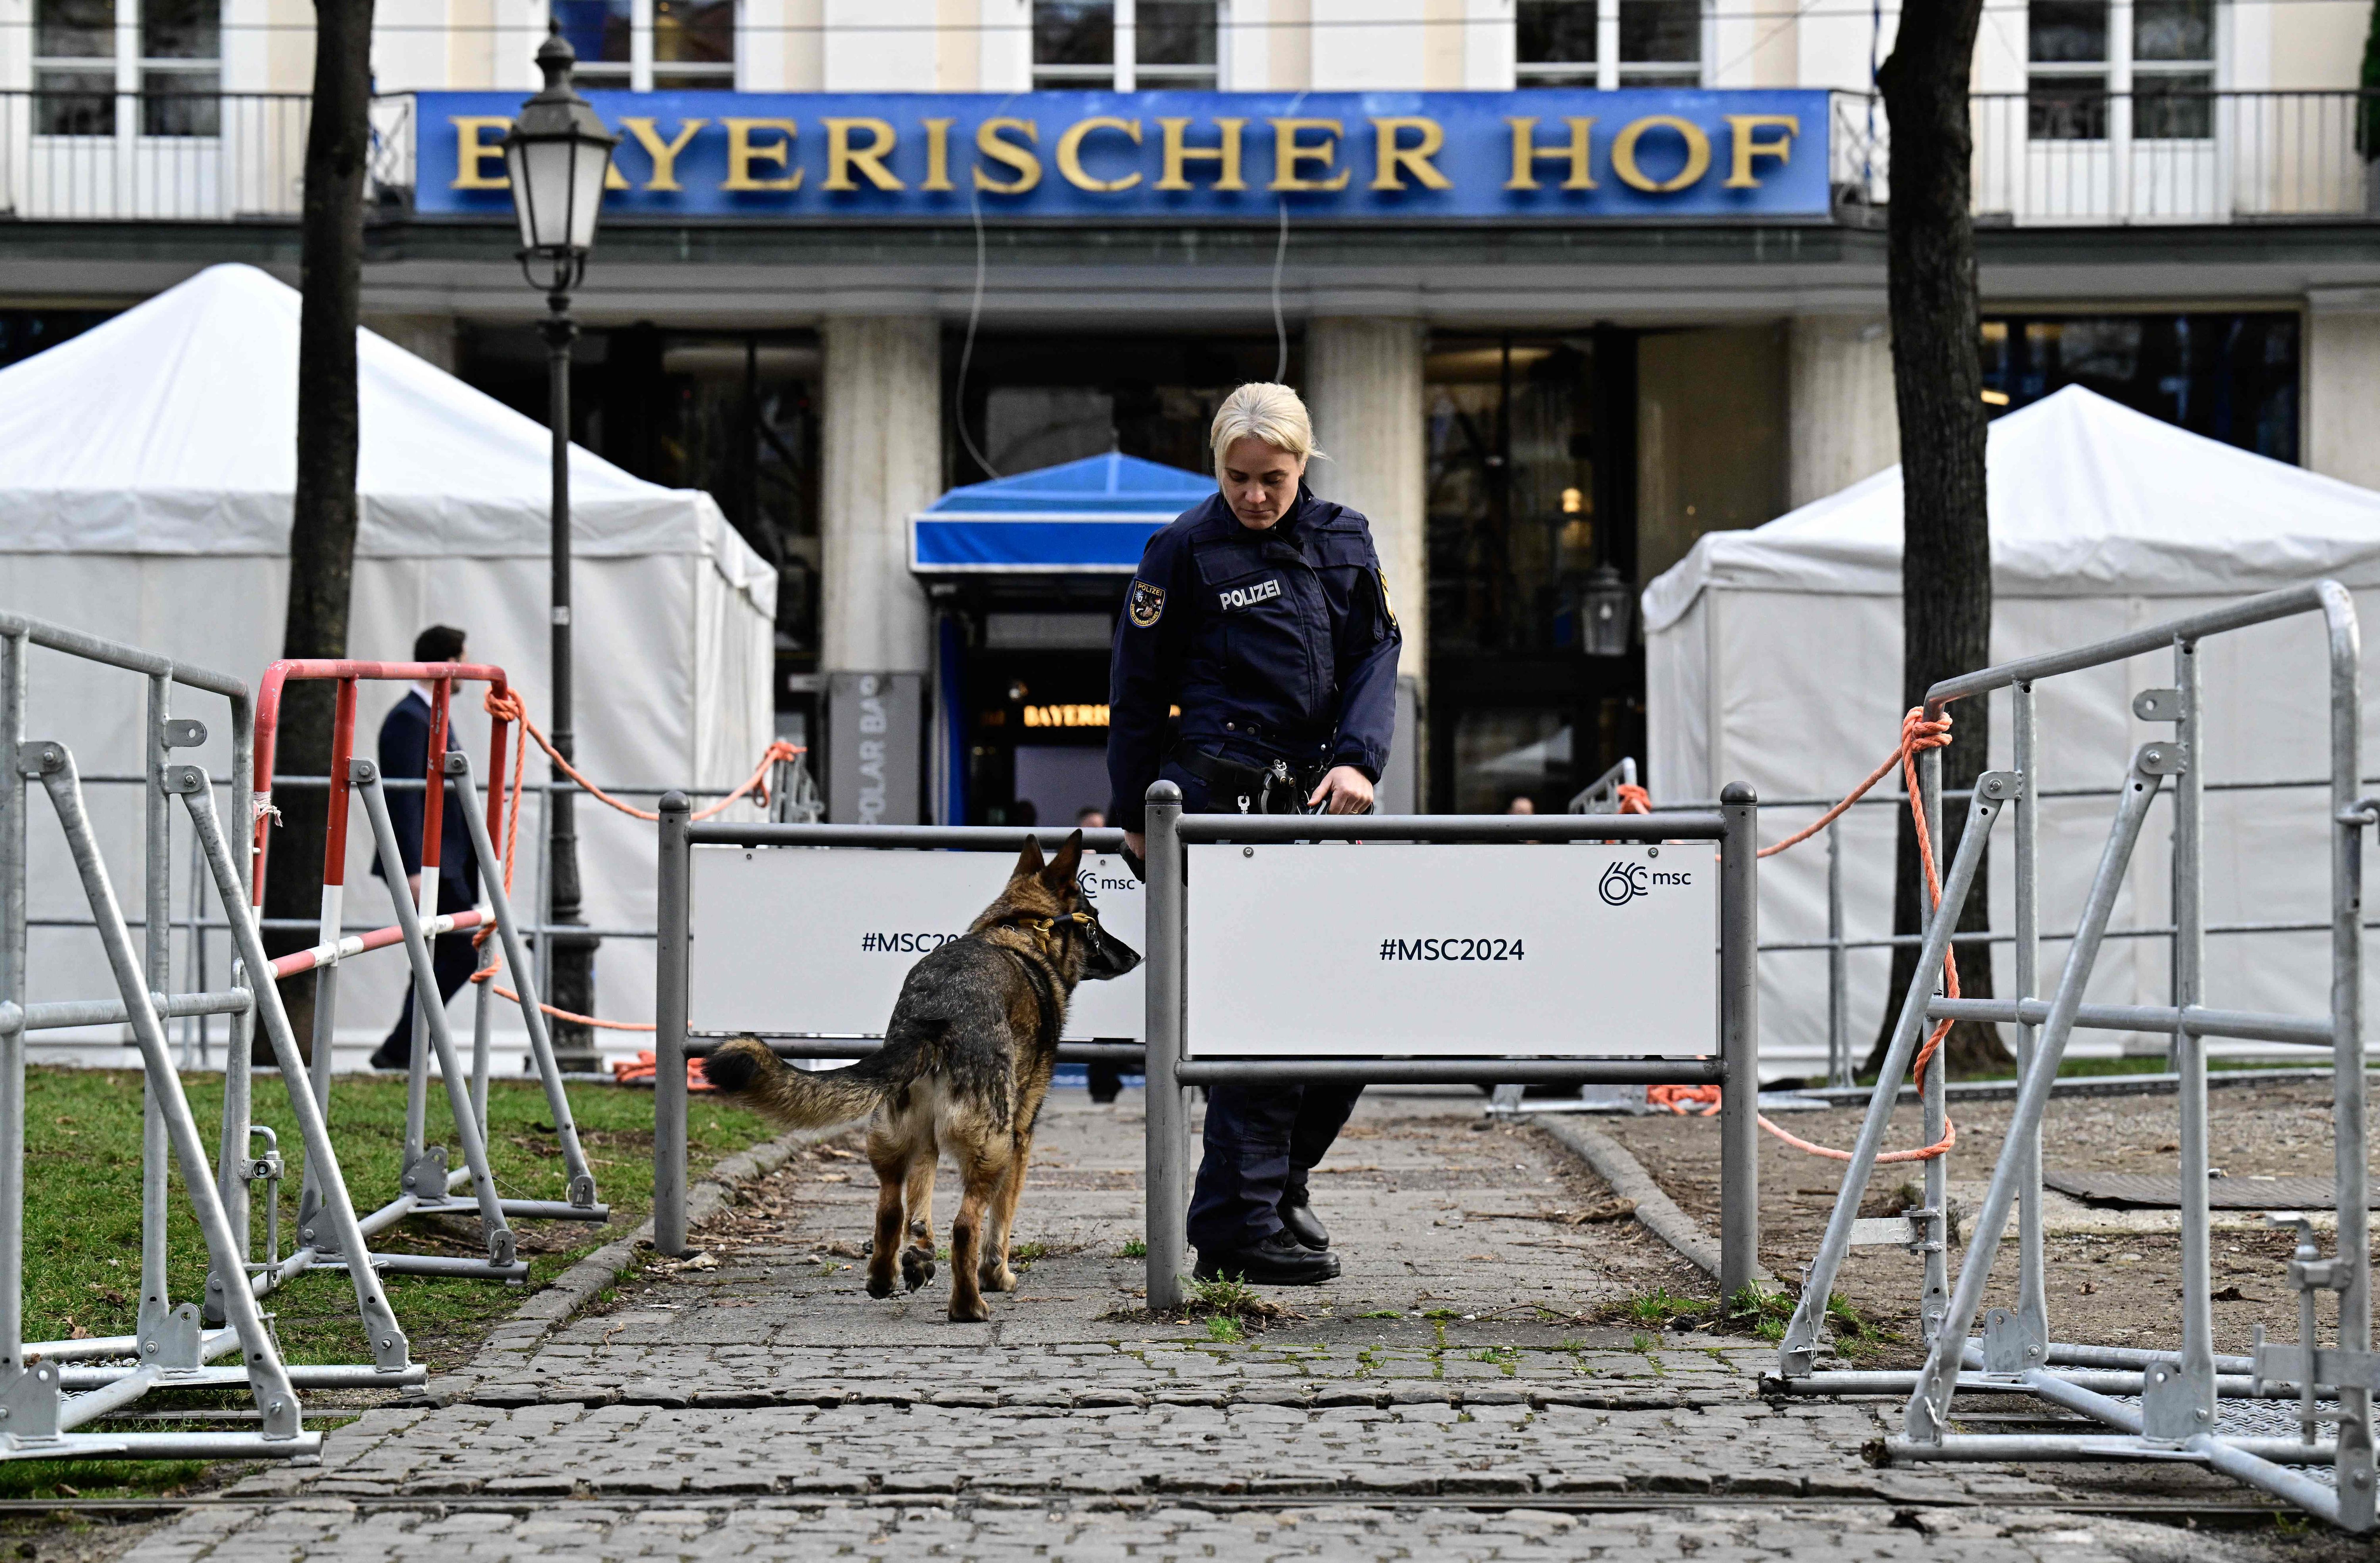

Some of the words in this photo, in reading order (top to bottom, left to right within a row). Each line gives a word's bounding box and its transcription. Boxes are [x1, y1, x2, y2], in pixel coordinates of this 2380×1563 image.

[449, 116, 1452, 192] BYERISCHER
[1504, 114, 1799, 193] HOF
[1138, 584, 1162, 597] POLIZEI
[1219, 579, 1281, 610] POLIZEI
[1131, 603, 1159, 625] DIENSTHUNDEFÜHRER
[1102, 879, 1135, 889] msc
[1653, 873, 1691, 885] msc
[1380, 939, 1524, 960] #MSC2024
